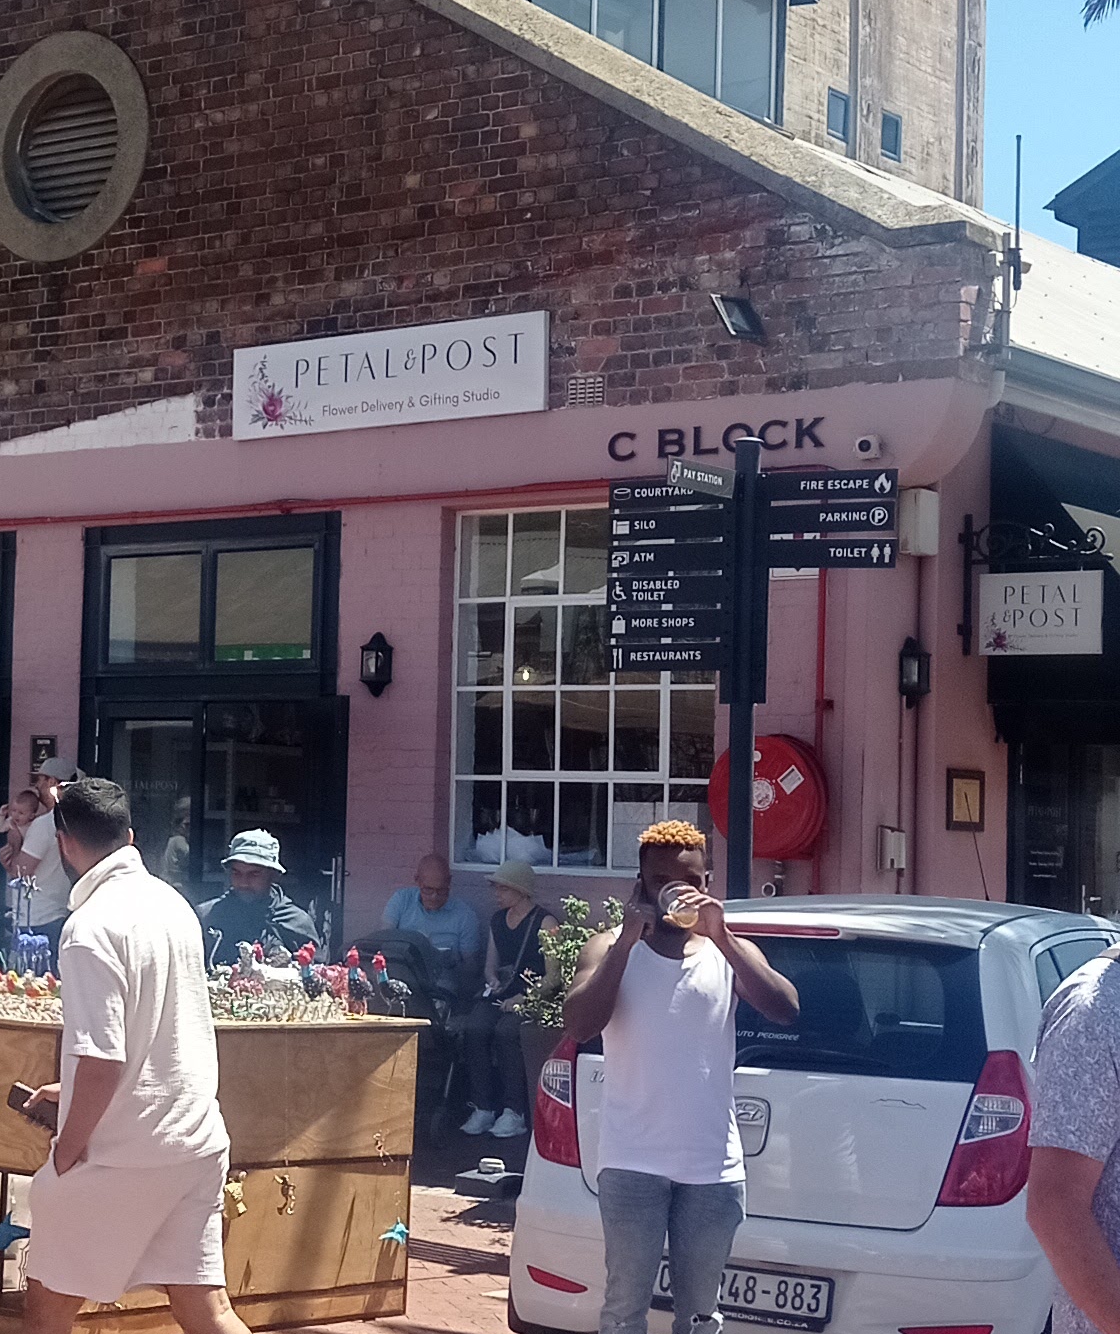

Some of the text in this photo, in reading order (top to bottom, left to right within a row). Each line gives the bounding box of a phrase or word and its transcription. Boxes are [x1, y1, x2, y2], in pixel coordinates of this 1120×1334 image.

[322, 387, 501, 418] Flower Delivery & Gifting Studio
[607, 417, 825, 462] C BLOCK
[683, 468, 723, 486] PAY STATION
[800, 479, 870, 490] FIRE ESCAPE
[819, 511, 867, 522] PARKING
[634, 520, 656, 530] SILO
[633, 552, 655, 562] ATM
[829, 547, 867, 557] TOILET
[632, 579, 680, 590] DISABLED
[631, 591, 665, 601] TOILET
[1004, 583, 1080, 605] PETAL
[631, 617, 695, 628] MORE SHOPS
[630, 650, 702, 661] RESTAURANTS
[736, 1030, 754, 1038] UTO
